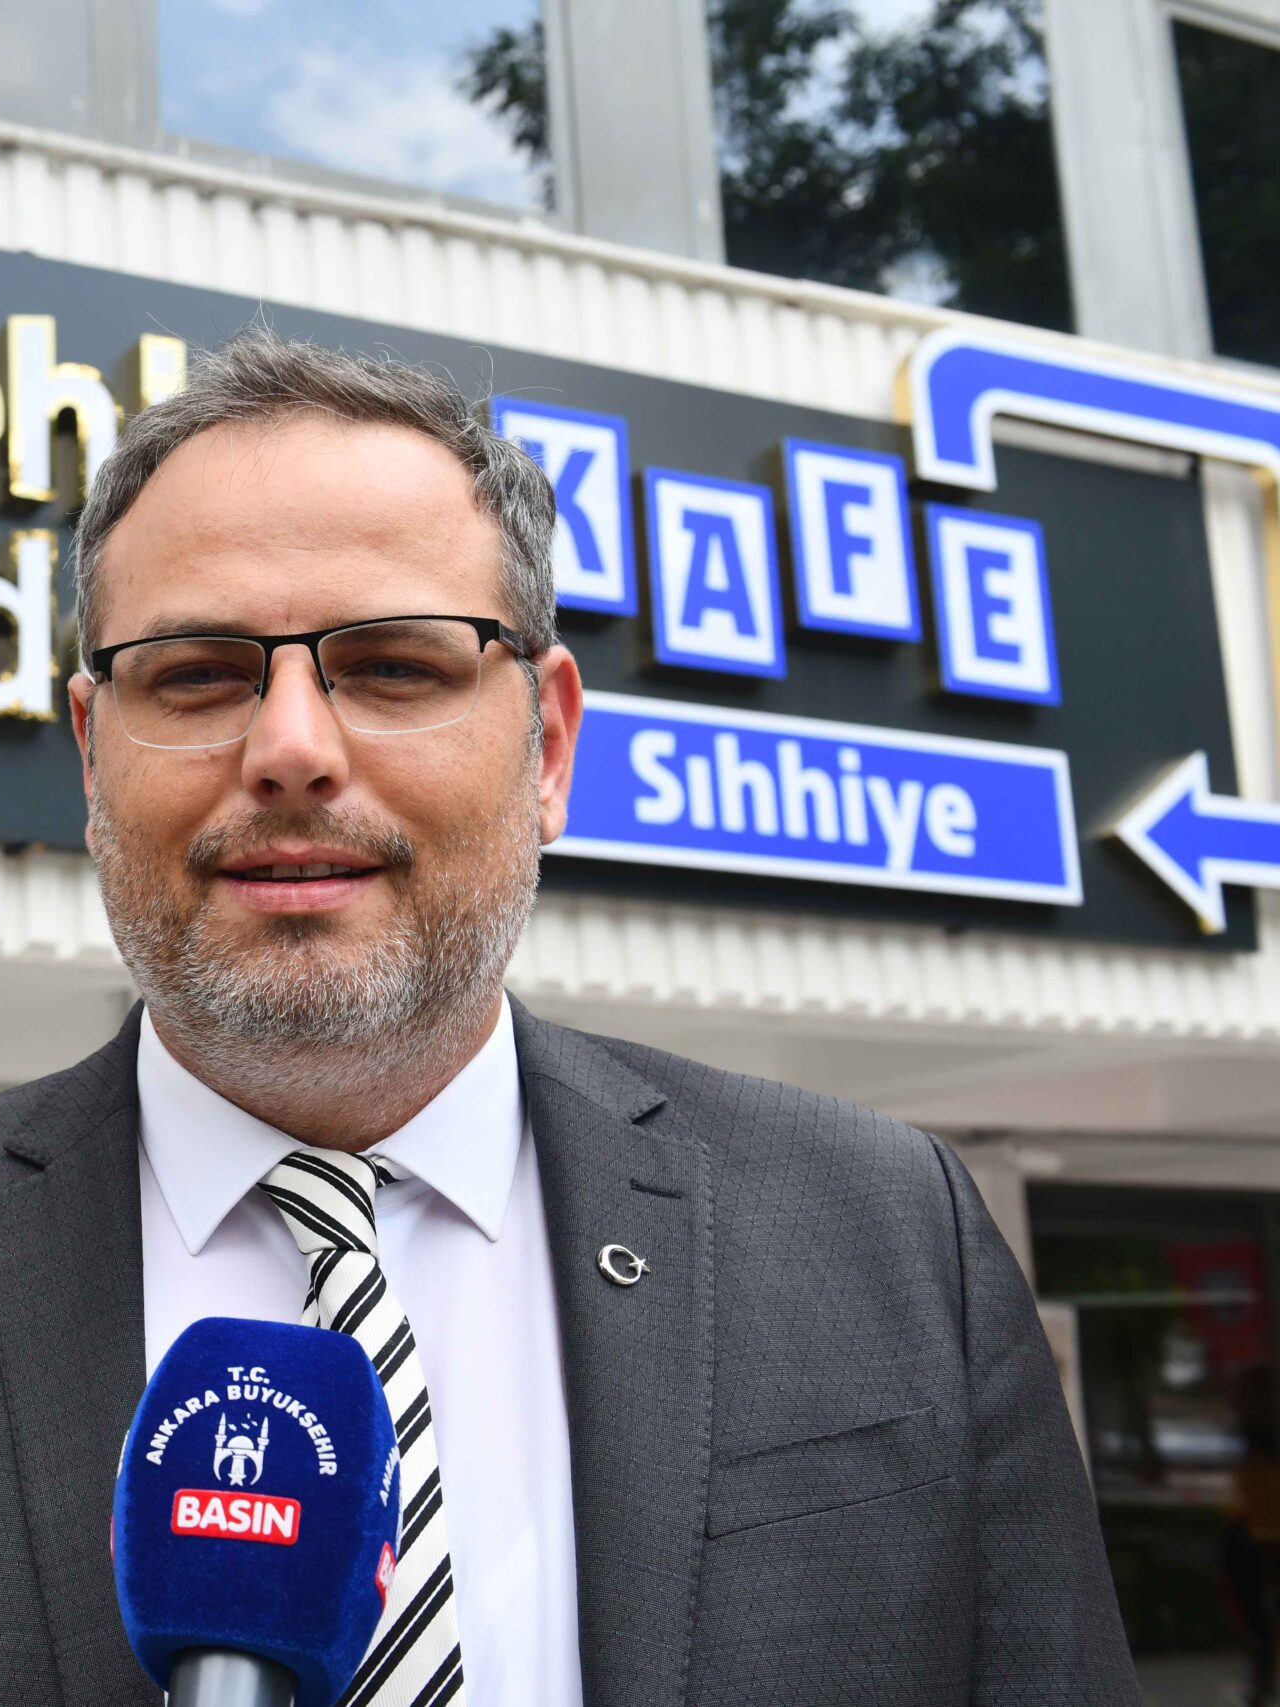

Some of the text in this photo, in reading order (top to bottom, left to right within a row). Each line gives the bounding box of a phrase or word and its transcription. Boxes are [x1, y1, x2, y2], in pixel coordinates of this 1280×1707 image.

[629, 729, 978, 873] Sıhhiye
[227, 1366, 270, 1384] T.C.
[146, 1390, 220, 1466] ANKARA
[177, 1496, 295, 1538] BASIN
